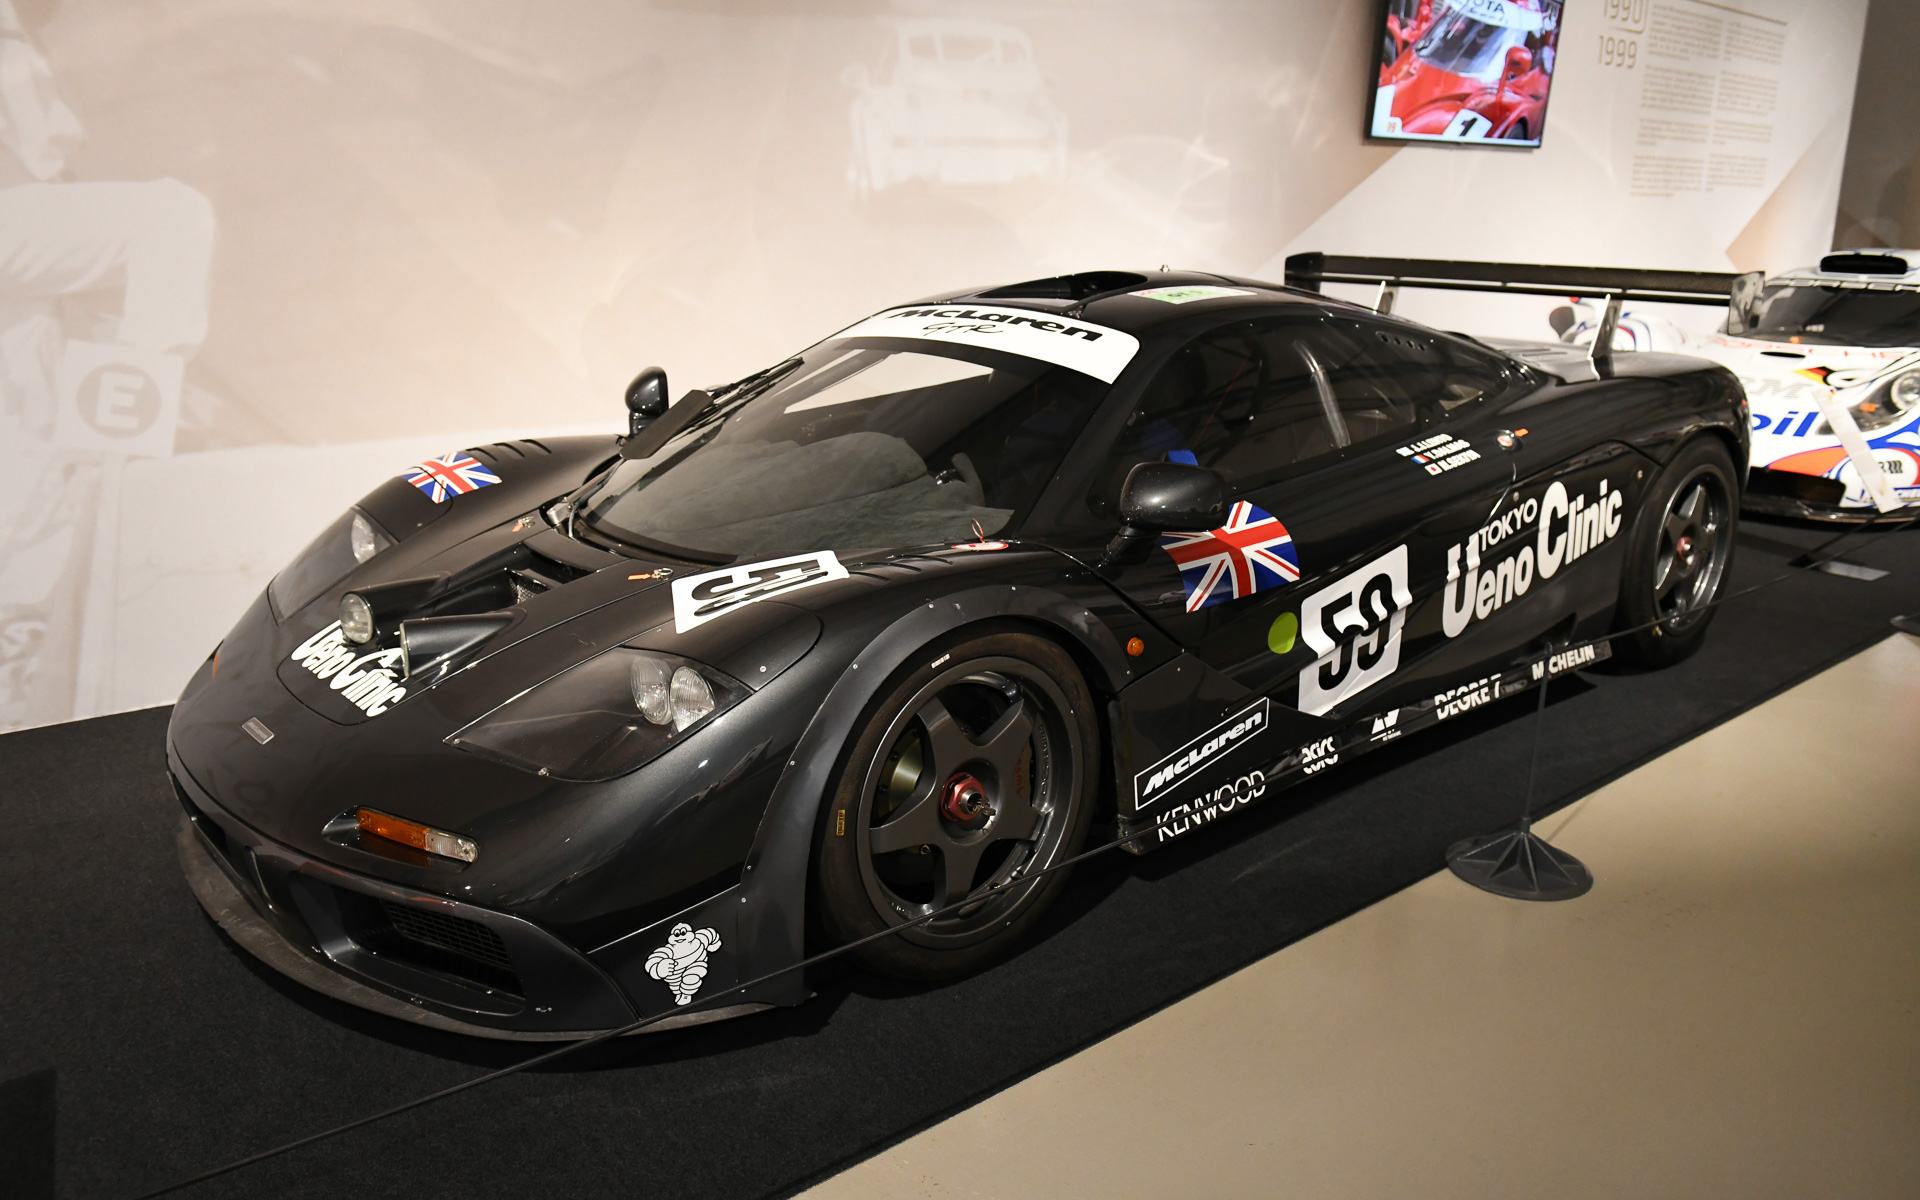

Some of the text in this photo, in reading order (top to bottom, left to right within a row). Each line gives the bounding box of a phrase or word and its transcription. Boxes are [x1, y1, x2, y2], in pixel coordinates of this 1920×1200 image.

[1598, 35, 1638, 69] 1999
[1460, 117, 1479, 137] 1
[887, 308, 1104, 342] McLaren
[95, 371, 145, 430] E
[1478, 498, 1538, 551] TOKYO
[1442, 479, 1622, 638] Ueno Clinic
[1318, 572, 1398, 691] 59
[291, 620, 407, 718] Ueno Clinic
[1532, 645, 1595, 681] MCHELIN
[1142, 711, 1262, 797] McLaren
[1156, 770, 1266, 842] KENWOOD
